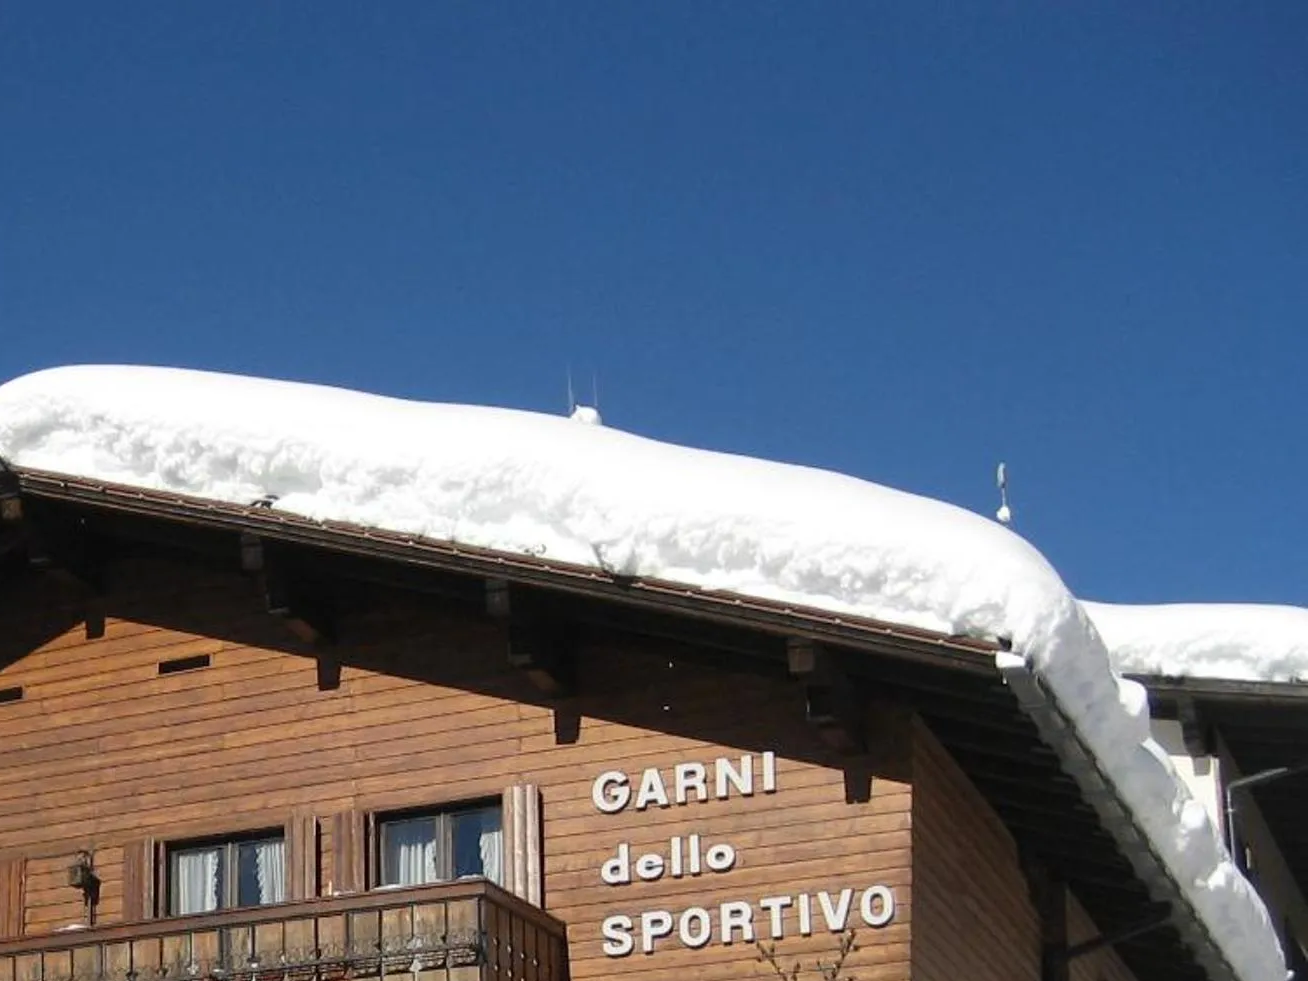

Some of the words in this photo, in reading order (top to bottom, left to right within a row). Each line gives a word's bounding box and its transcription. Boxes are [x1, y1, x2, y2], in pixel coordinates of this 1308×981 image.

[592, 751, 776, 813] GARNI
[601, 834, 735, 884] dello
[602, 885, 894, 956] SPORTIVO
